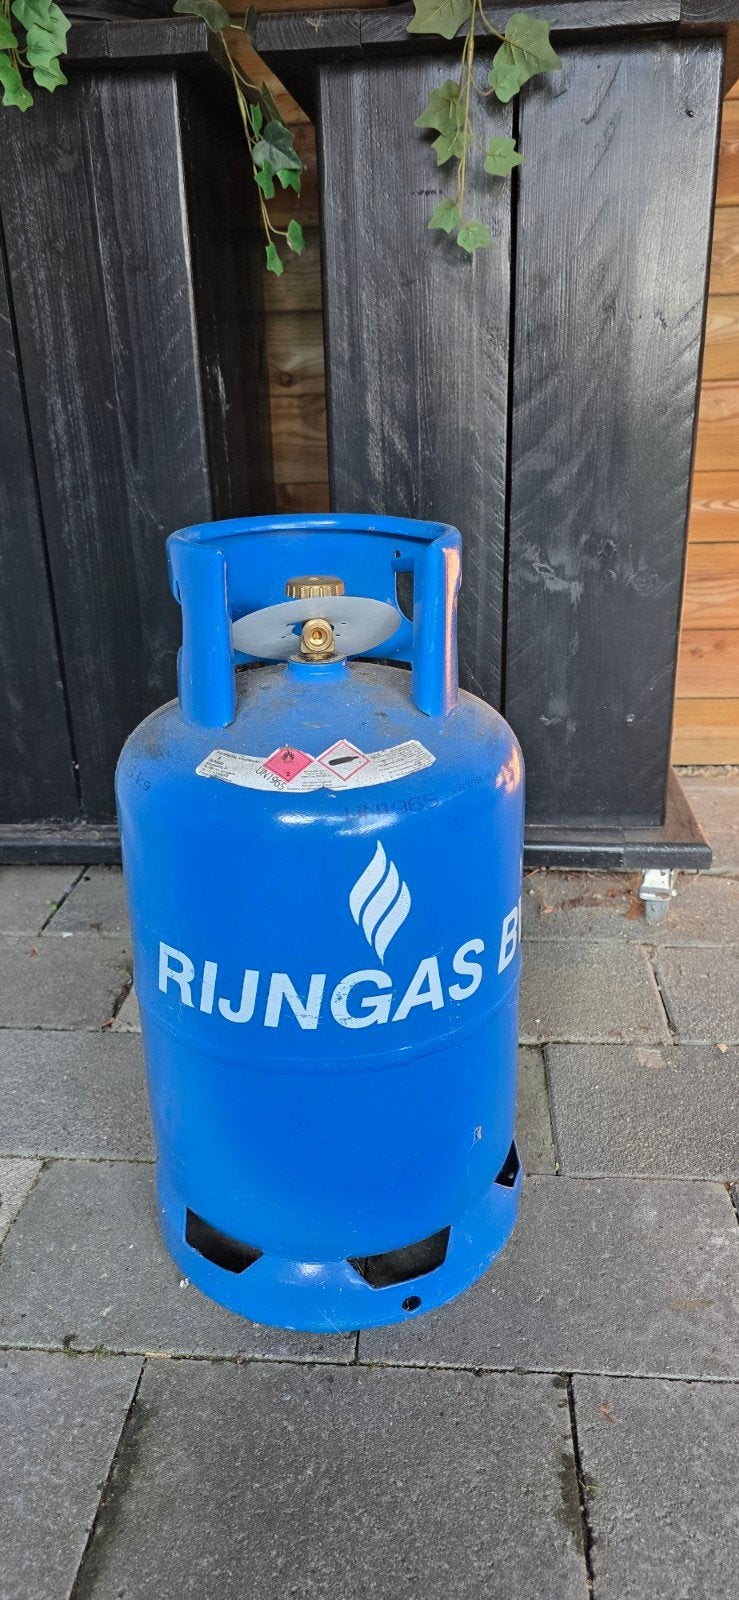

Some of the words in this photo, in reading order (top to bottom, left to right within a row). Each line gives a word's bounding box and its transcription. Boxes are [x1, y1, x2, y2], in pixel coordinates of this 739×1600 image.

[256, 766, 287, 791] UN1965
[343, 793, 439, 817] UN1965
[158, 938, 485, 1030] RIJNGAS
